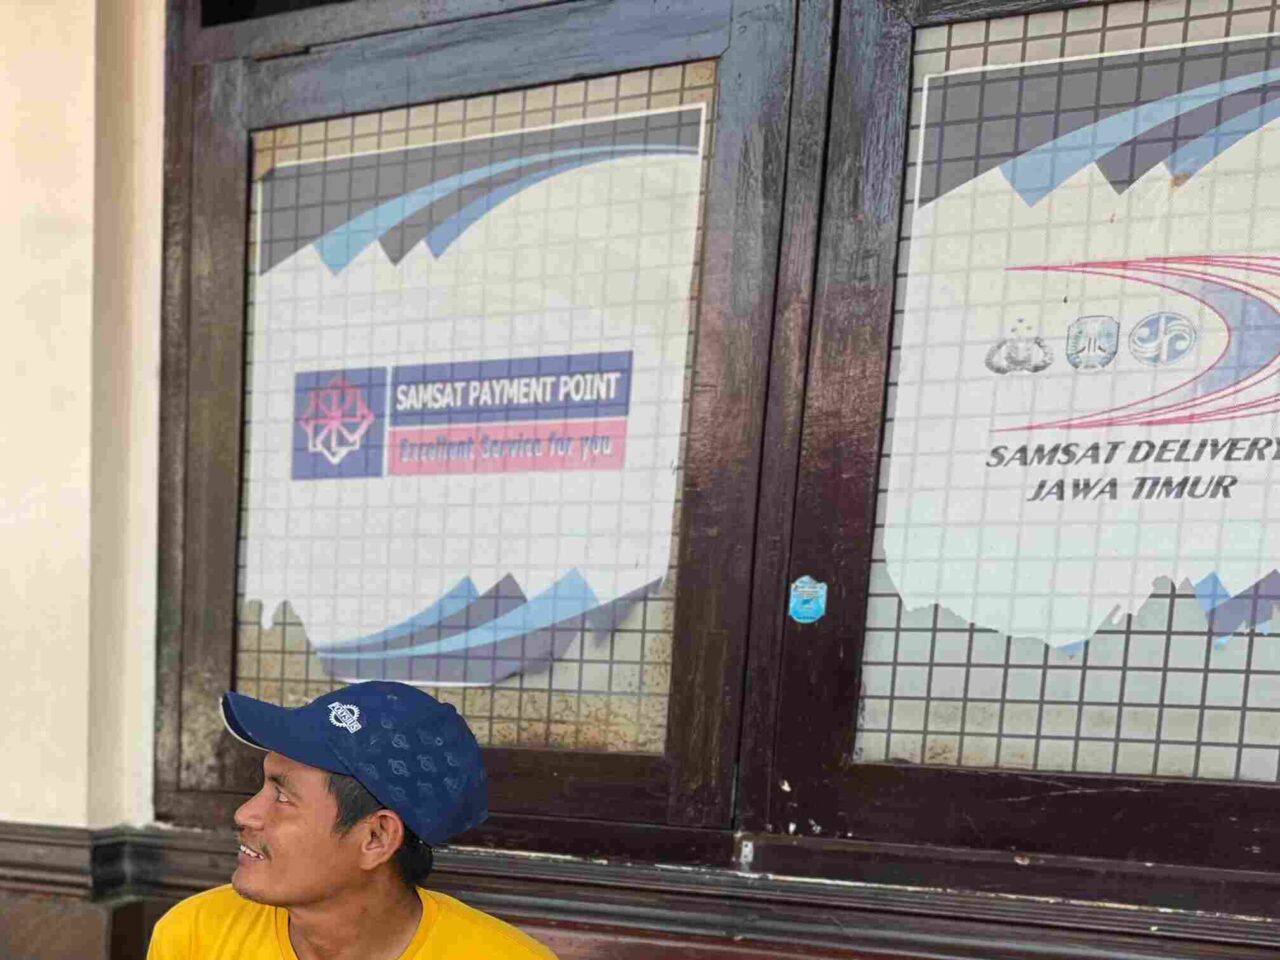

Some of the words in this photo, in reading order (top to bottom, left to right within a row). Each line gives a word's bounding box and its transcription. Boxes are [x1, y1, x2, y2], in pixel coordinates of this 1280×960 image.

[396, 382, 467, 411] SAMSAT
[468, 376, 557, 406] PAYMENT
[559, 371, 622, 402] POINT
[481, 432, 544, 459] Service
[549, 430, 575, 457] for
[580, 433, 613, 462] you
[985, 441, 1126, 467] SAMSAT
[1026, 477, 1118, 501] JAWA
[1131, 475, 1239, 499] TIMUR
